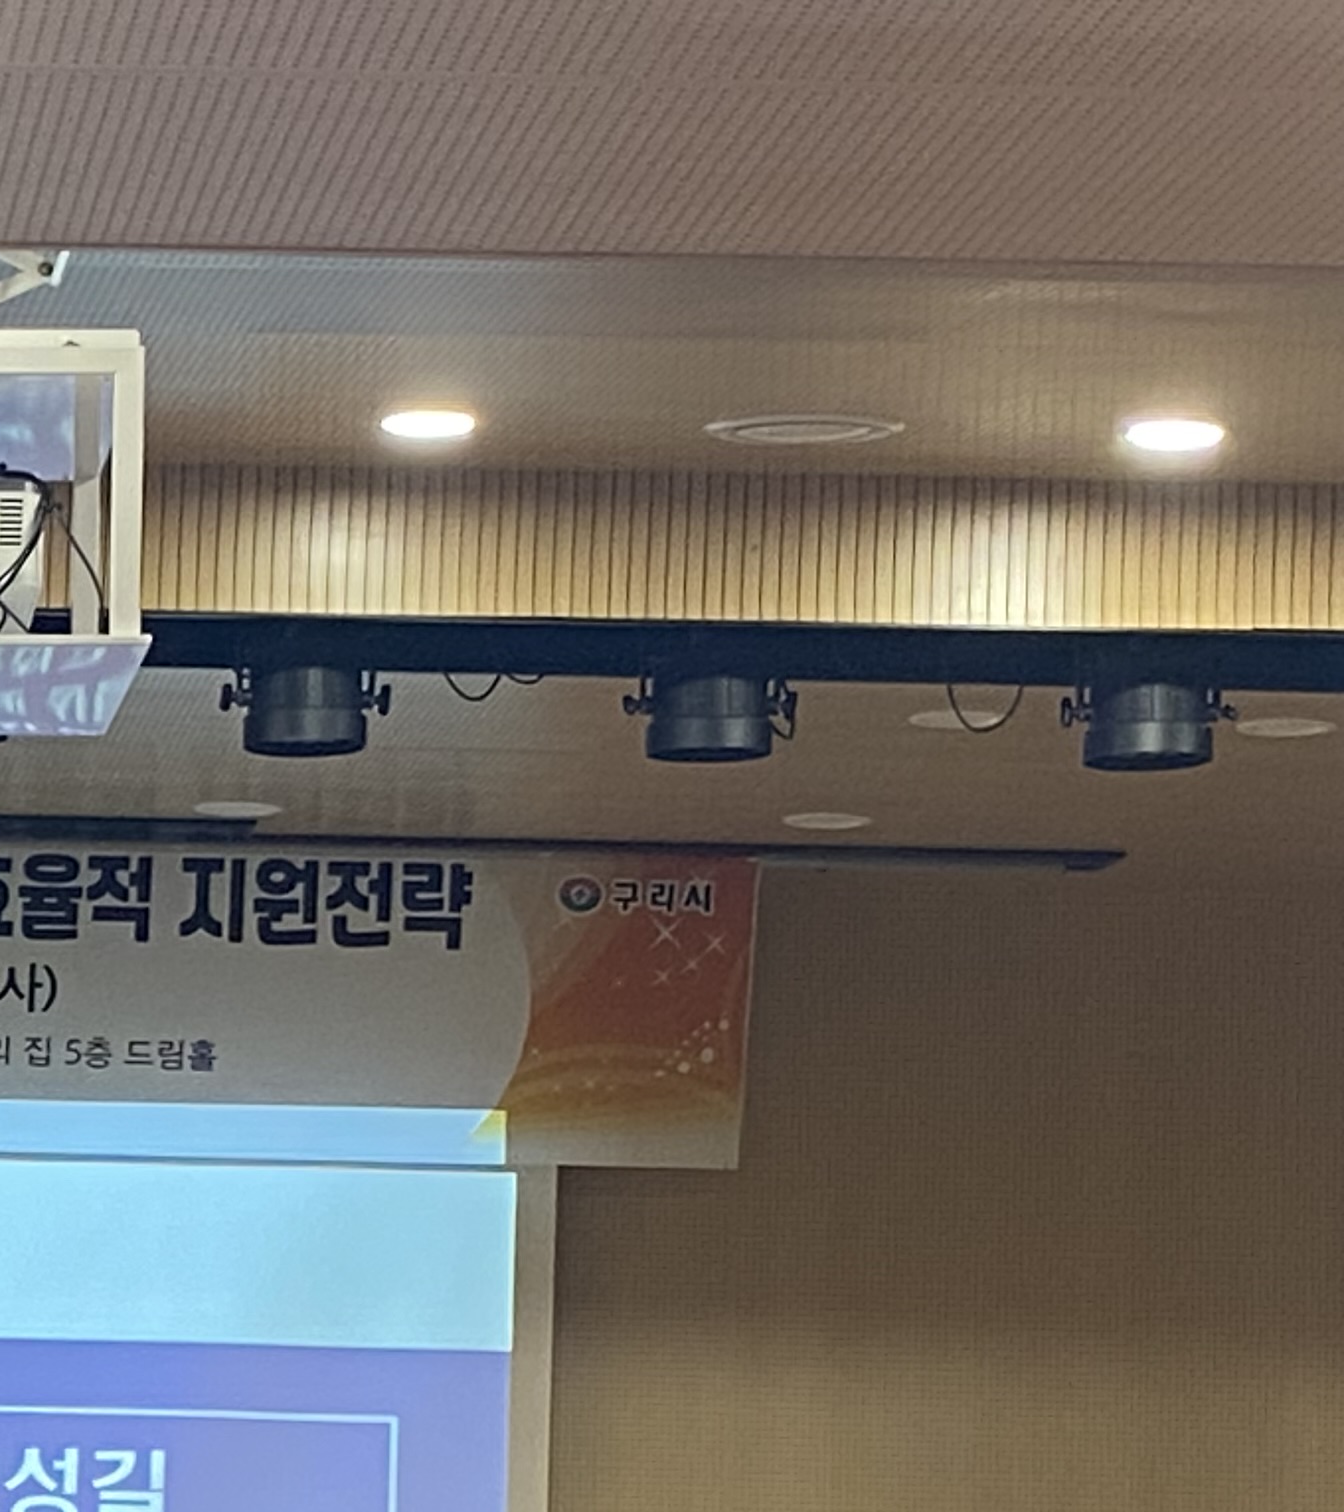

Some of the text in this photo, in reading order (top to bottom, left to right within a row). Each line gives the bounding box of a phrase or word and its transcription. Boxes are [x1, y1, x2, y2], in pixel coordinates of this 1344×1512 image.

[178, 856, 475, 950] 지원전략
[612, 881, 714, 915] 구리시
[23, 1035, 54, 1068] 집
[65, 1037, 112, 1070] 5층
[123, 1038, 217, 1073] 드림홀
